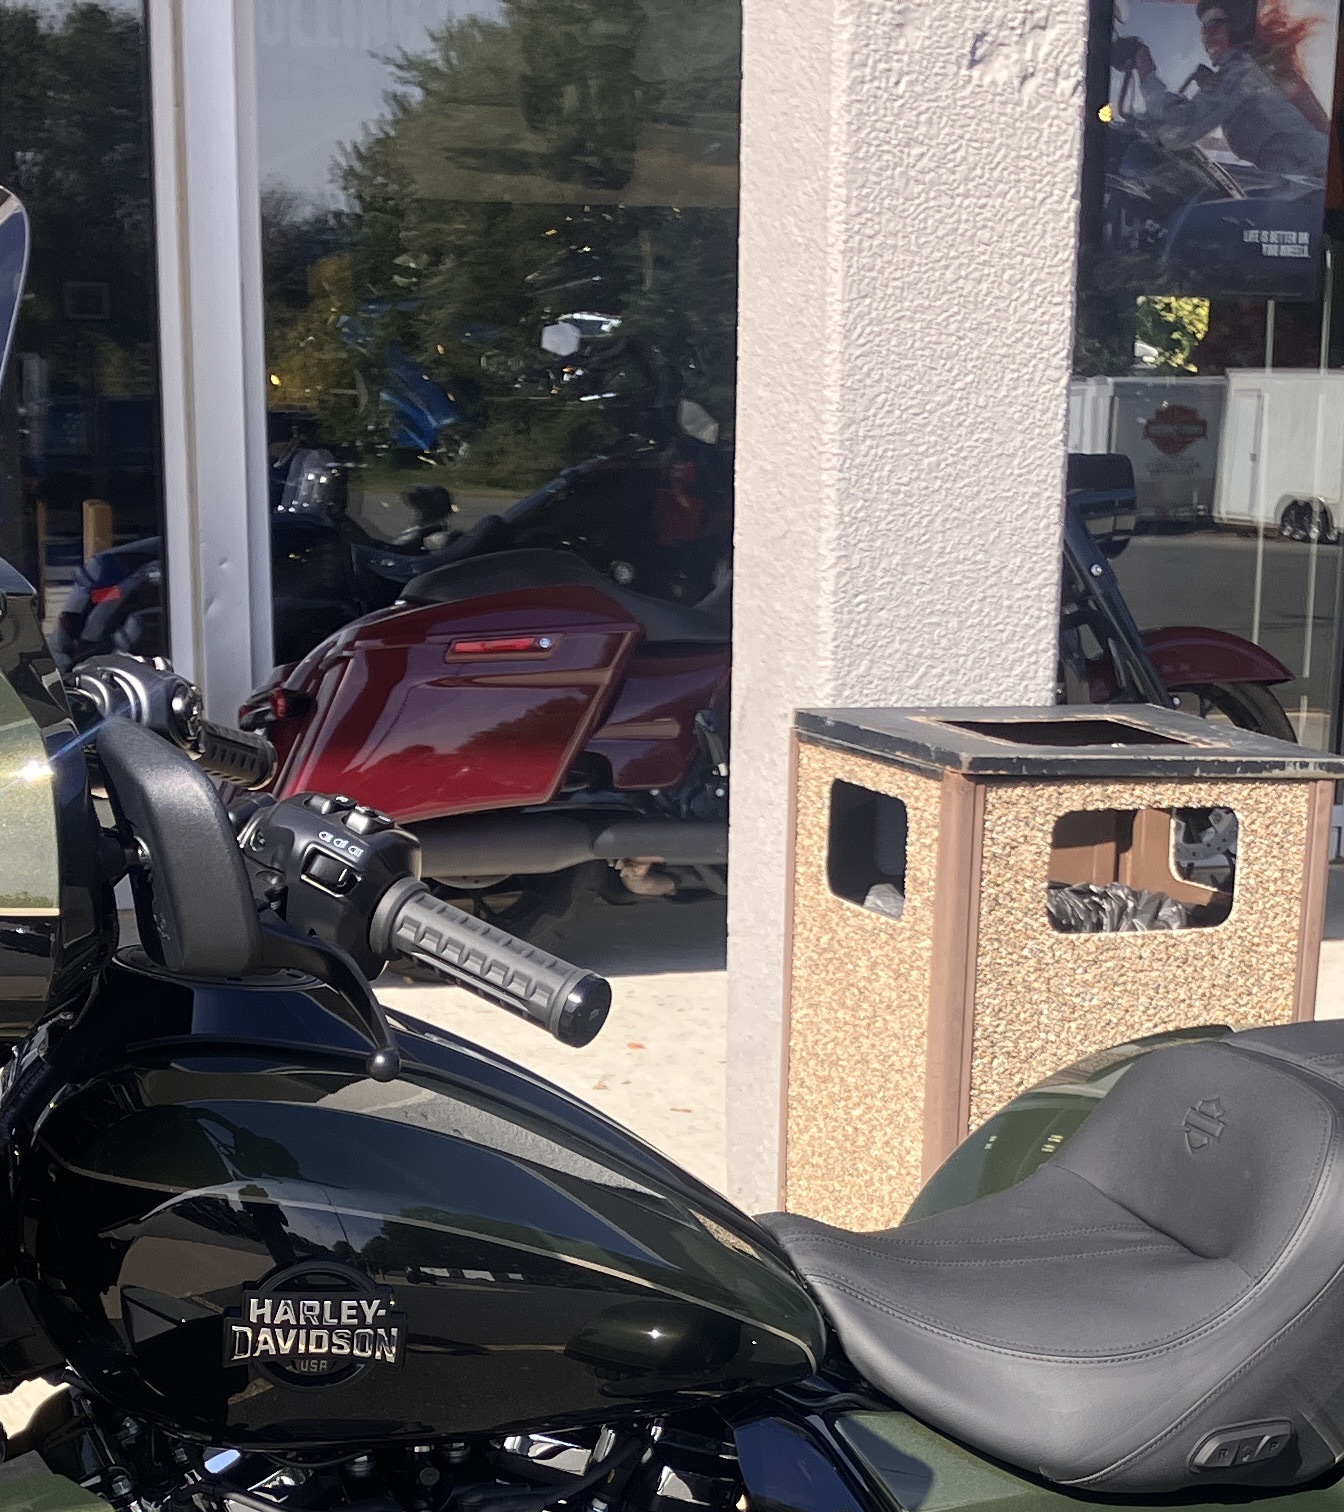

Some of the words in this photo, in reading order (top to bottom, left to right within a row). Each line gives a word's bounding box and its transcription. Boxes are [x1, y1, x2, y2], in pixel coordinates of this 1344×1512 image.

[249, 1298, 386, 1326] HARLEY-
[231, 1325, 398, 1363] DAVIDSON
[299, 1359, 328, 1373] USA
